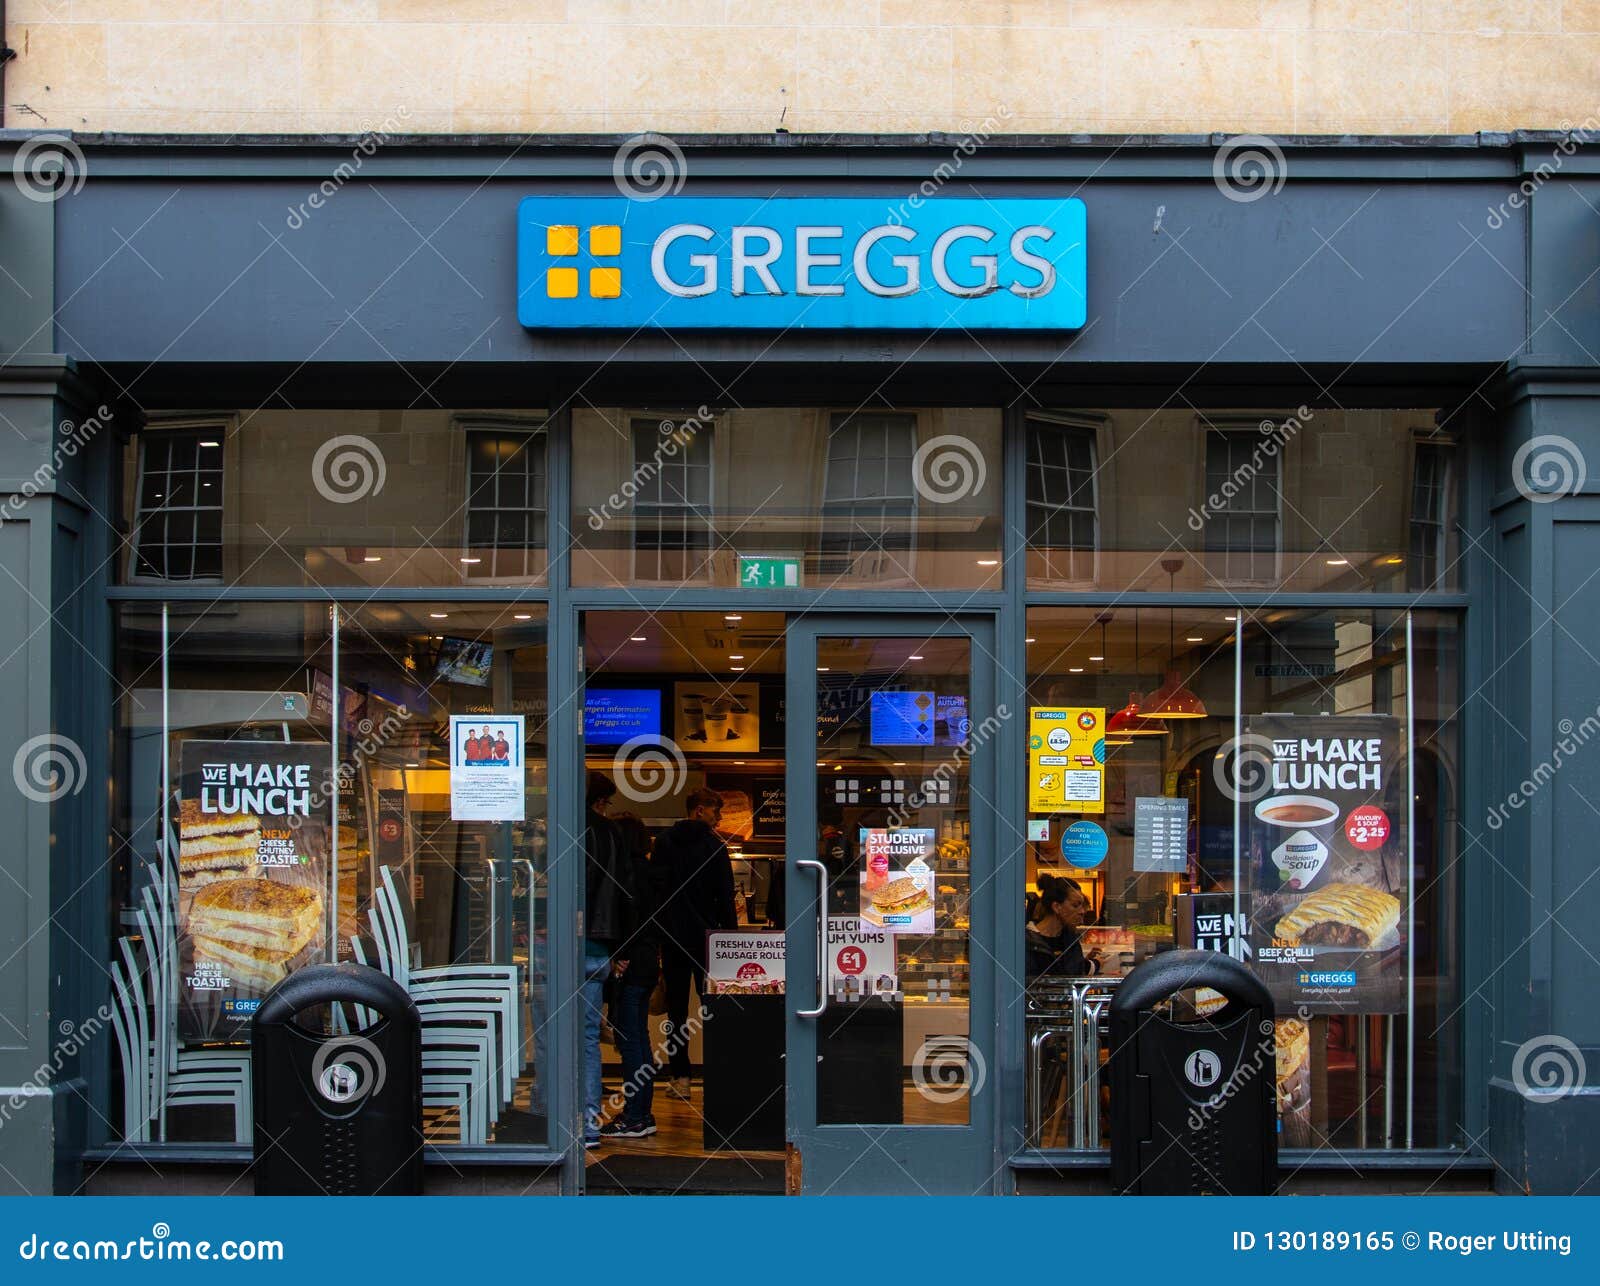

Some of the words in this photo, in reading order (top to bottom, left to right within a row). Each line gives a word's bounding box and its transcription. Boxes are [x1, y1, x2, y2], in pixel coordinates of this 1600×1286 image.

[650, 223, 1058, 298] GREGGS
[1272, 744, 1298, 756] WE
[1301, 738, 1382, 762] MAKE
[202, 768, 227, 780] WE
[230, 763, 311, 787] MAKE
[1272, 763, 1381, 790] LUNCH
[201, 787, 310, 816] LUNCH
[262, 829, 292, 839] NEW
[869, 833, 926, 844] STUDENT
[258, 839, 287, 847] CHEESE
[869, 845, 925, 855] EXCLUSIVE
[255, 855, 299, 865] TOASTIE
[1288, 859, 1320, 870] soup
[1197, 919, 1221, 932] WE
[850, 932, 885, 943] YUMS
[1272, 938, 1300, 947] NEW
[715, 940, 753, 949] FRESHLY
[715, 951, 757, 960] SAUSAGE
[1258, 948, 1282, 957] BEEF
[1284, 948, 1314, 957] CHILLI
[842, 952, 862, 968] £1
[194, 970, 222, 978] CHEESE
[1311, 974, 1353, 983] GREGGS
[186, 978, 231, 988] TOASTIE
